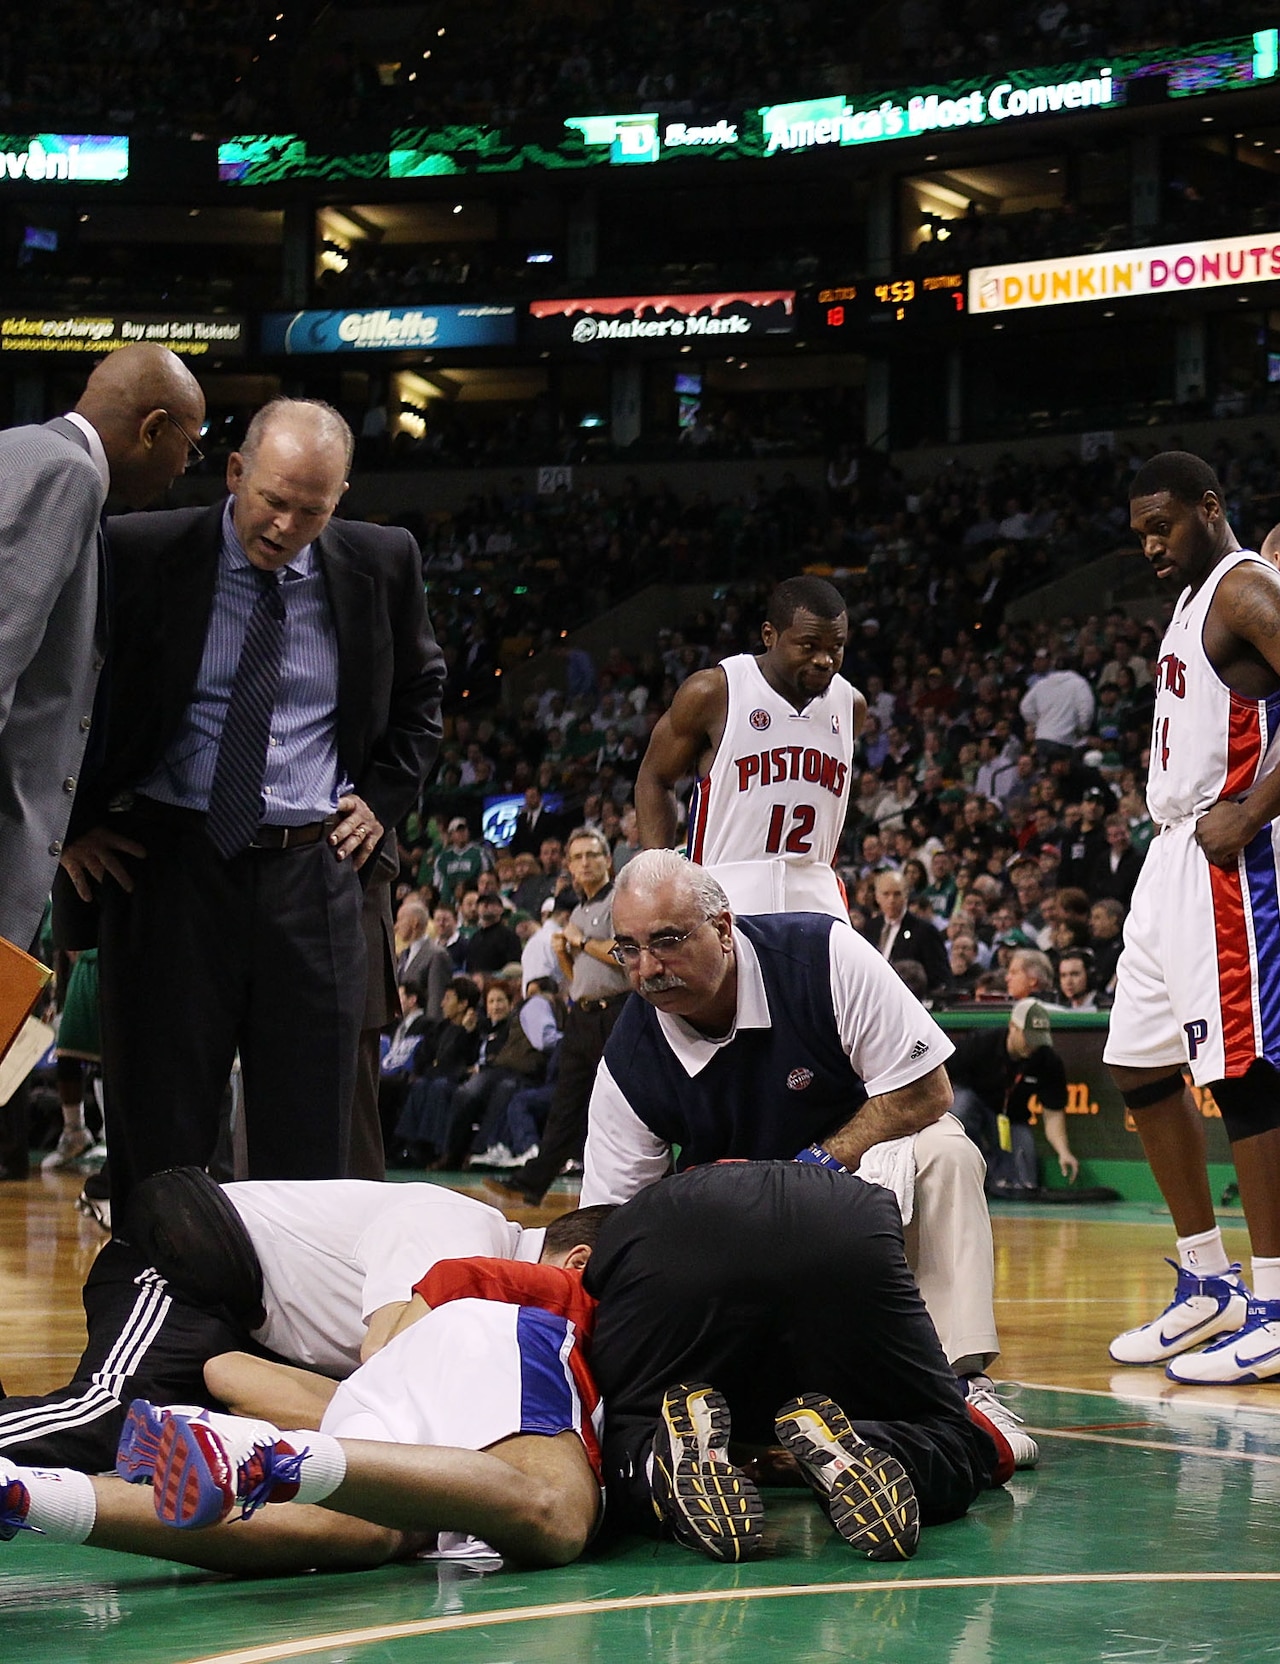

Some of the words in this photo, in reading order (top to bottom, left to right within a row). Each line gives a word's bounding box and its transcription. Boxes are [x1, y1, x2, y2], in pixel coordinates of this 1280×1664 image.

[767, 100, 904, 151] America's
[908, 92, 987, 132] Most
[987, 68, 1114, 120] Conveni
[952, 292, 964, 311] 7
[1004, 260, 1143, 305] DUNKIN'
[121, 321, 146, 340] Buy
[145, 322, 170, 338] and
[338, 310, 439, 342] Gillette
[595, 316, 685, 339] Maker's
[684, 314, 752, 336] Mark
[734, 745, 848, 798] PISTONS
[765, 804, 816, 854] 12
